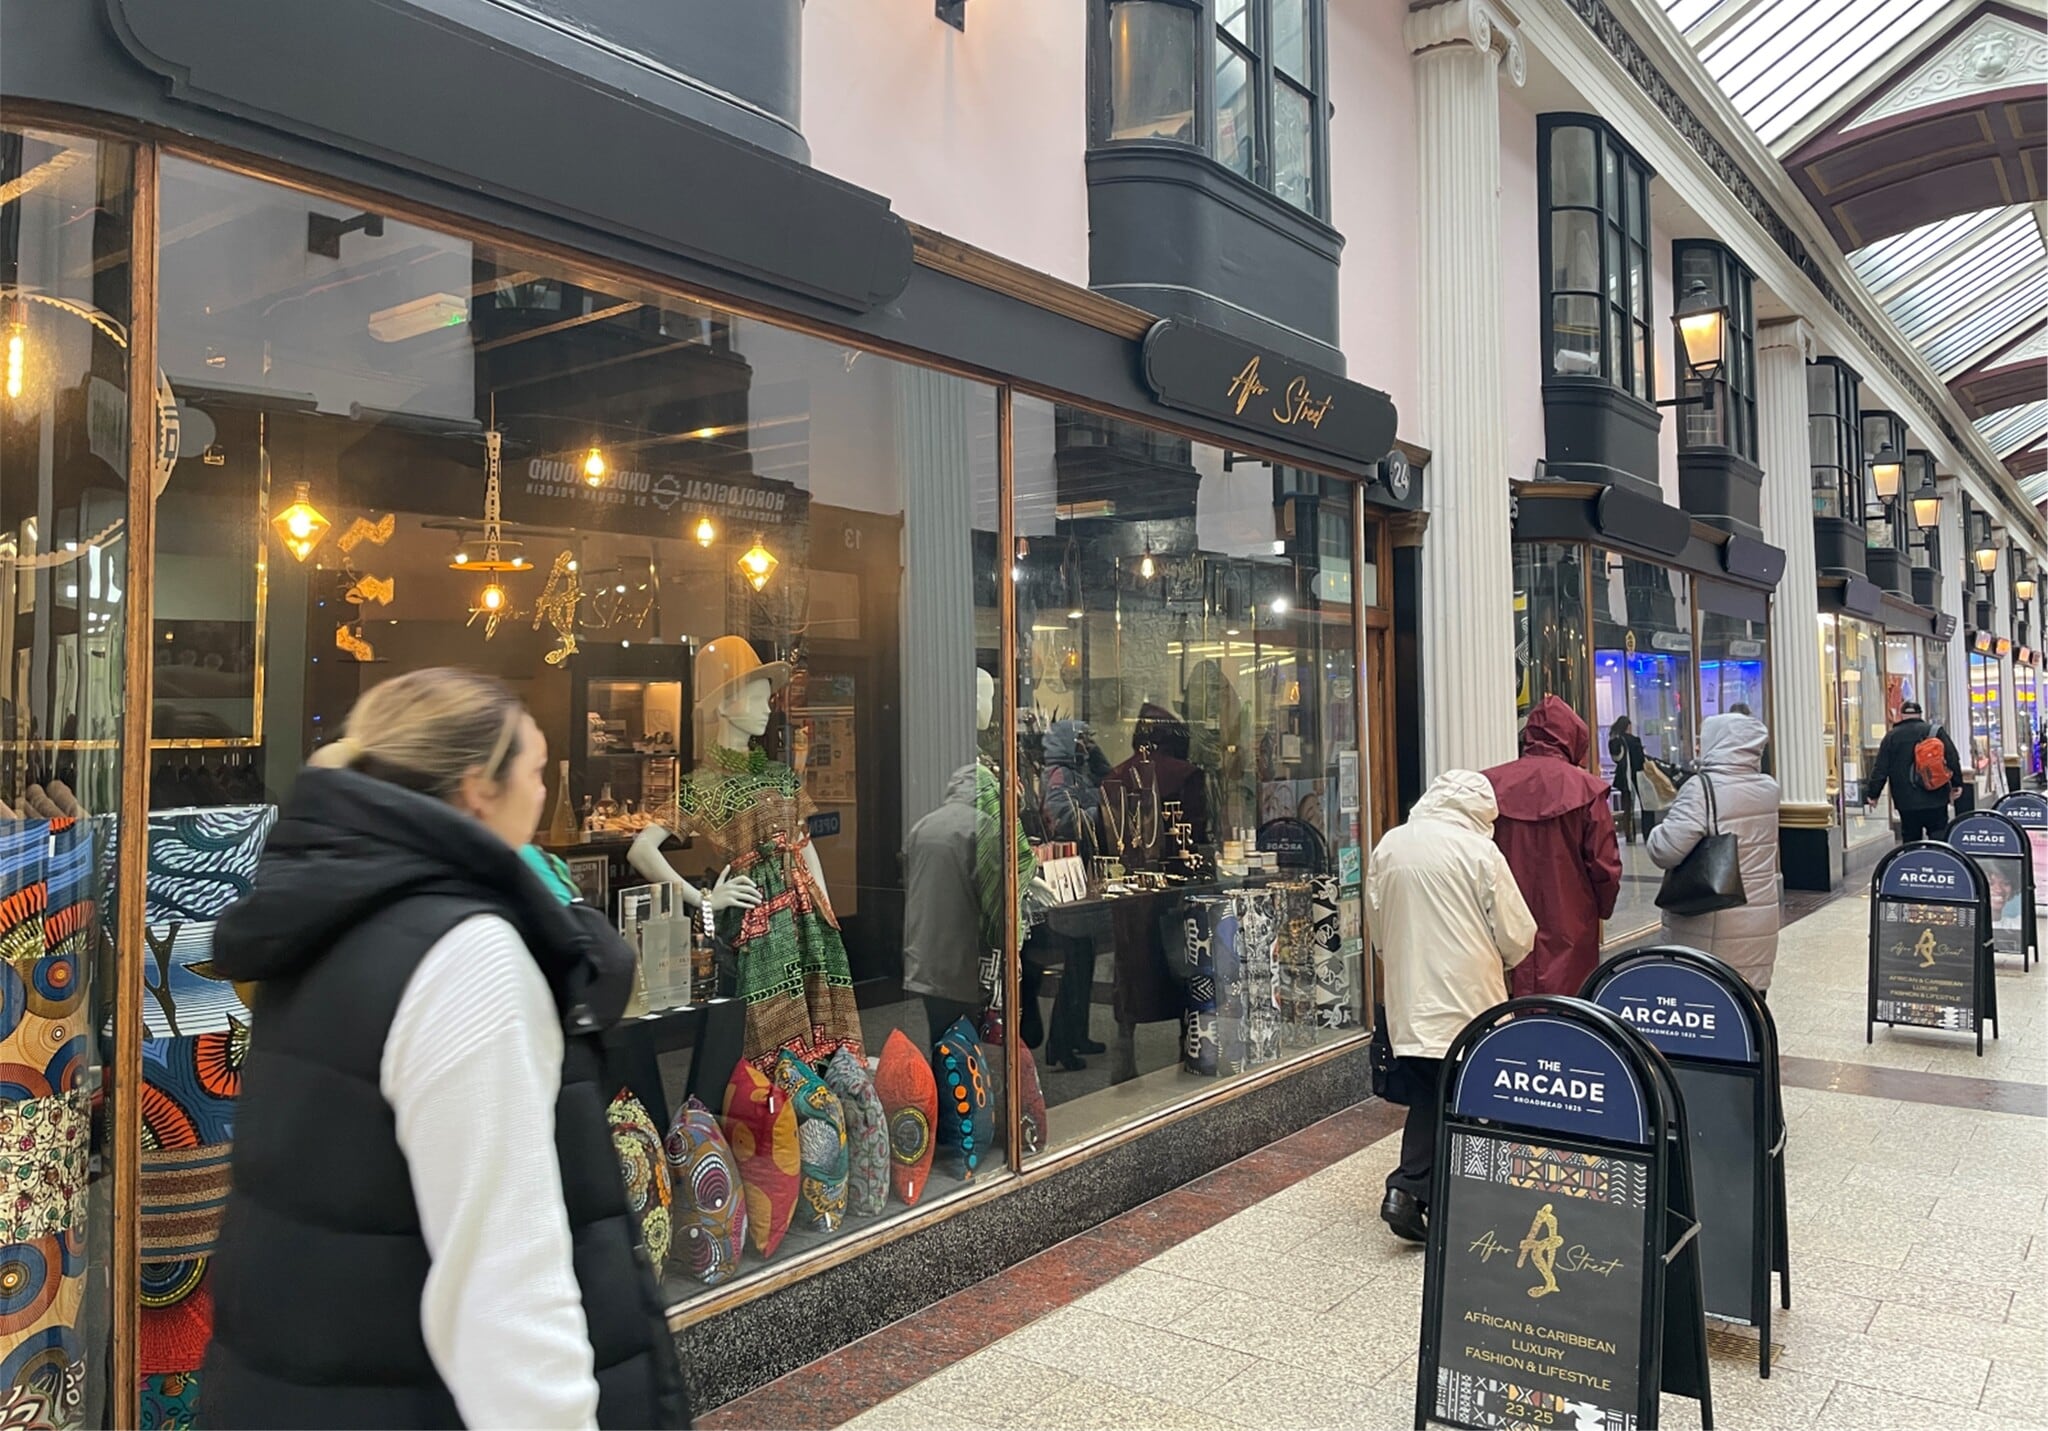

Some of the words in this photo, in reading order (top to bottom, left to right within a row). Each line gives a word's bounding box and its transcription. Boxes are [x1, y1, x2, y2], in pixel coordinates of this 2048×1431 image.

[1227, 355, 1269, 415] Afro
[1272, 375, 1334, 430] Street
[1393, 462, 1409, 489] 24
[2006, 810, 2042, 818] ARCADE
[1962, 834, 2006, 843] ARCADE
[1899, 872, 1956, 885] ARCADE
[1921, 866, 1934, 874] THE
[1656, 996, 1678, 1007] THE
[1619, 1005, 1716, 1030] ARCADE
[1681, 1031, 1697, 1039] 1825
[1537, 1059, 1561, 1073] THE
[1494, 1069, 1605, 1103] ARCADE
[1513, 1096, 1563, 1109] BROADMEAD
[1564, 1103, 1582, 1113] 1825
[1468, 1231, 1514, 1263] Afro
[1555, 1244, 1624, 1278] Street
[1464, 1311, 1522, 1333] AFRICAN
[1525, 1324, 1535, 1335] &
[1536, 1326, 1617, 1355] CARIBBEAN
[1511, 1338, 1565, 1361] LUXURY
[1465, 1346, 1524, 1370] FASHION
[1526, 1361, 1536, 1373] &
[1538, 1363, 1612, 1391] LIFESTYLE
